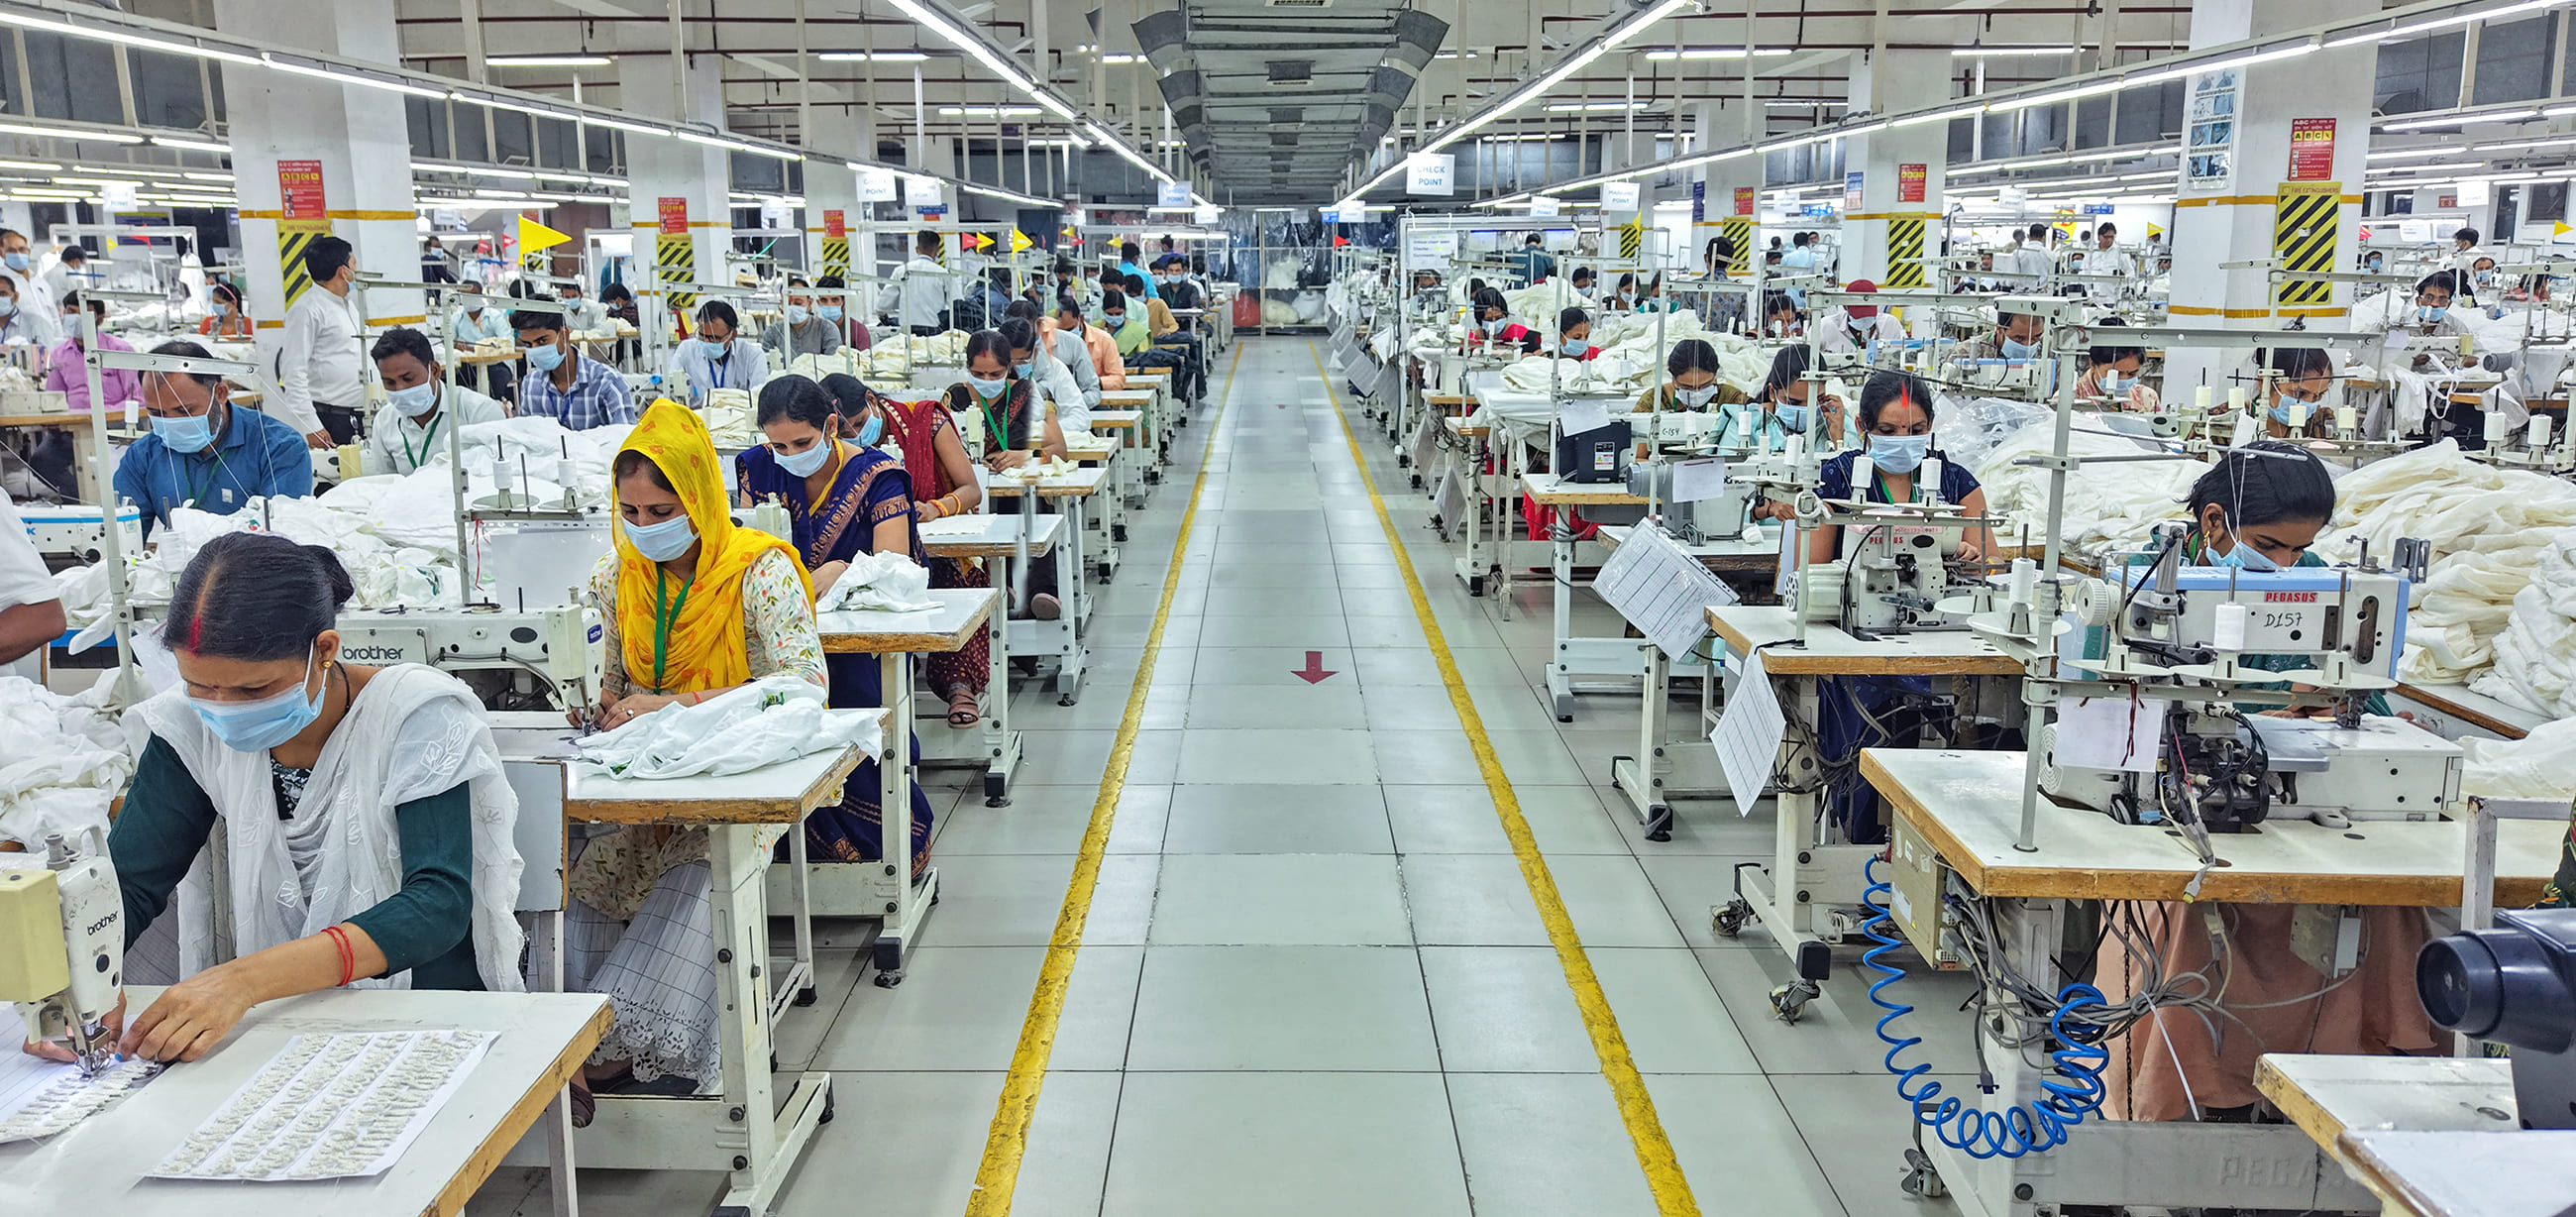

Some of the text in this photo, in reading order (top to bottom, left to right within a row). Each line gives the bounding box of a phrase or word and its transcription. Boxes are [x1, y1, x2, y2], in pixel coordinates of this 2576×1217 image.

[2265, 592, 2317, 603] PEGASUS
[2264, 612, 2303, 628] D157
[342, 646, 403, 660] brother
[87, 910, 118, 936] brother
